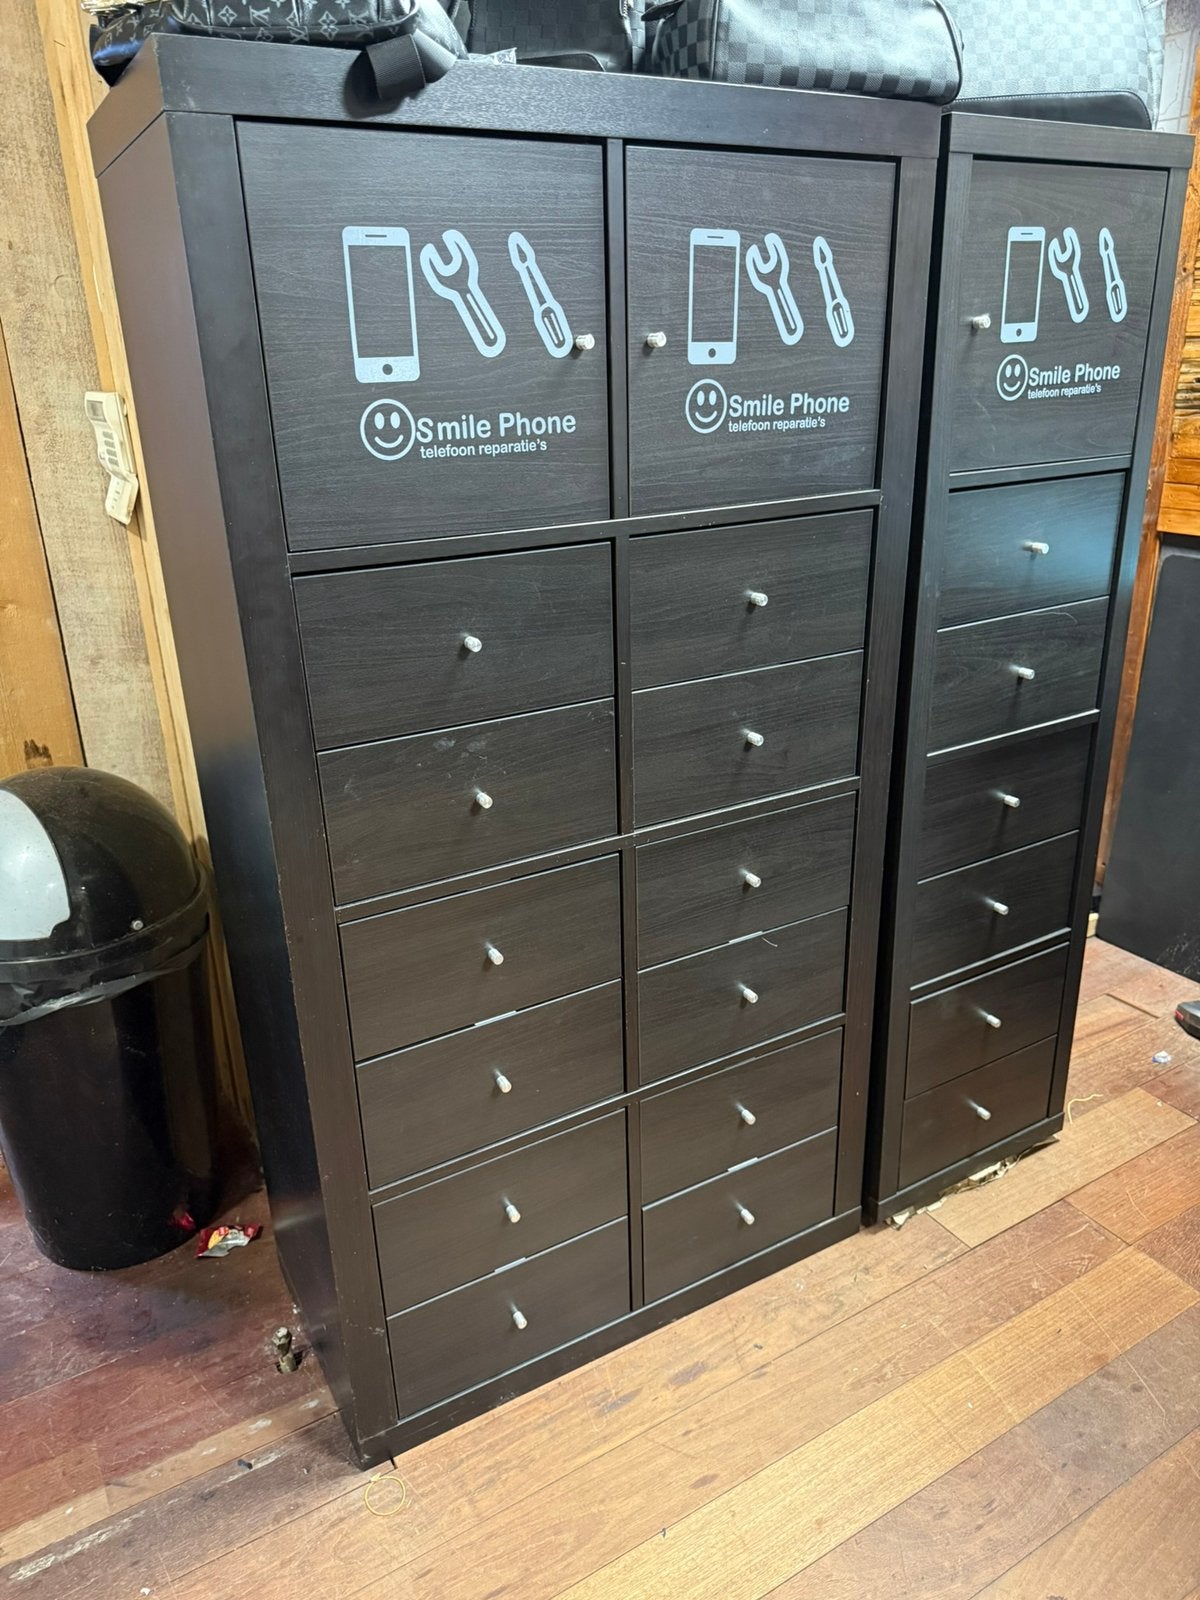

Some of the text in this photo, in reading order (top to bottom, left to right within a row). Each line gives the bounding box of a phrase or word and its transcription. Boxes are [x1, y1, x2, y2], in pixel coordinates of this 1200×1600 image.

[1028, 363, 1120, 386] Smile Phone
[1027, 383, 1101, 399] telefoon reparatie's
[729, 392, 849, 417] Smile Phone
[416, 412, 576, 443] Smile Phone
[728, 416, 826, 432] telefoon reparatie's
[420, 438, 547, 459] telefoon reparatie's
